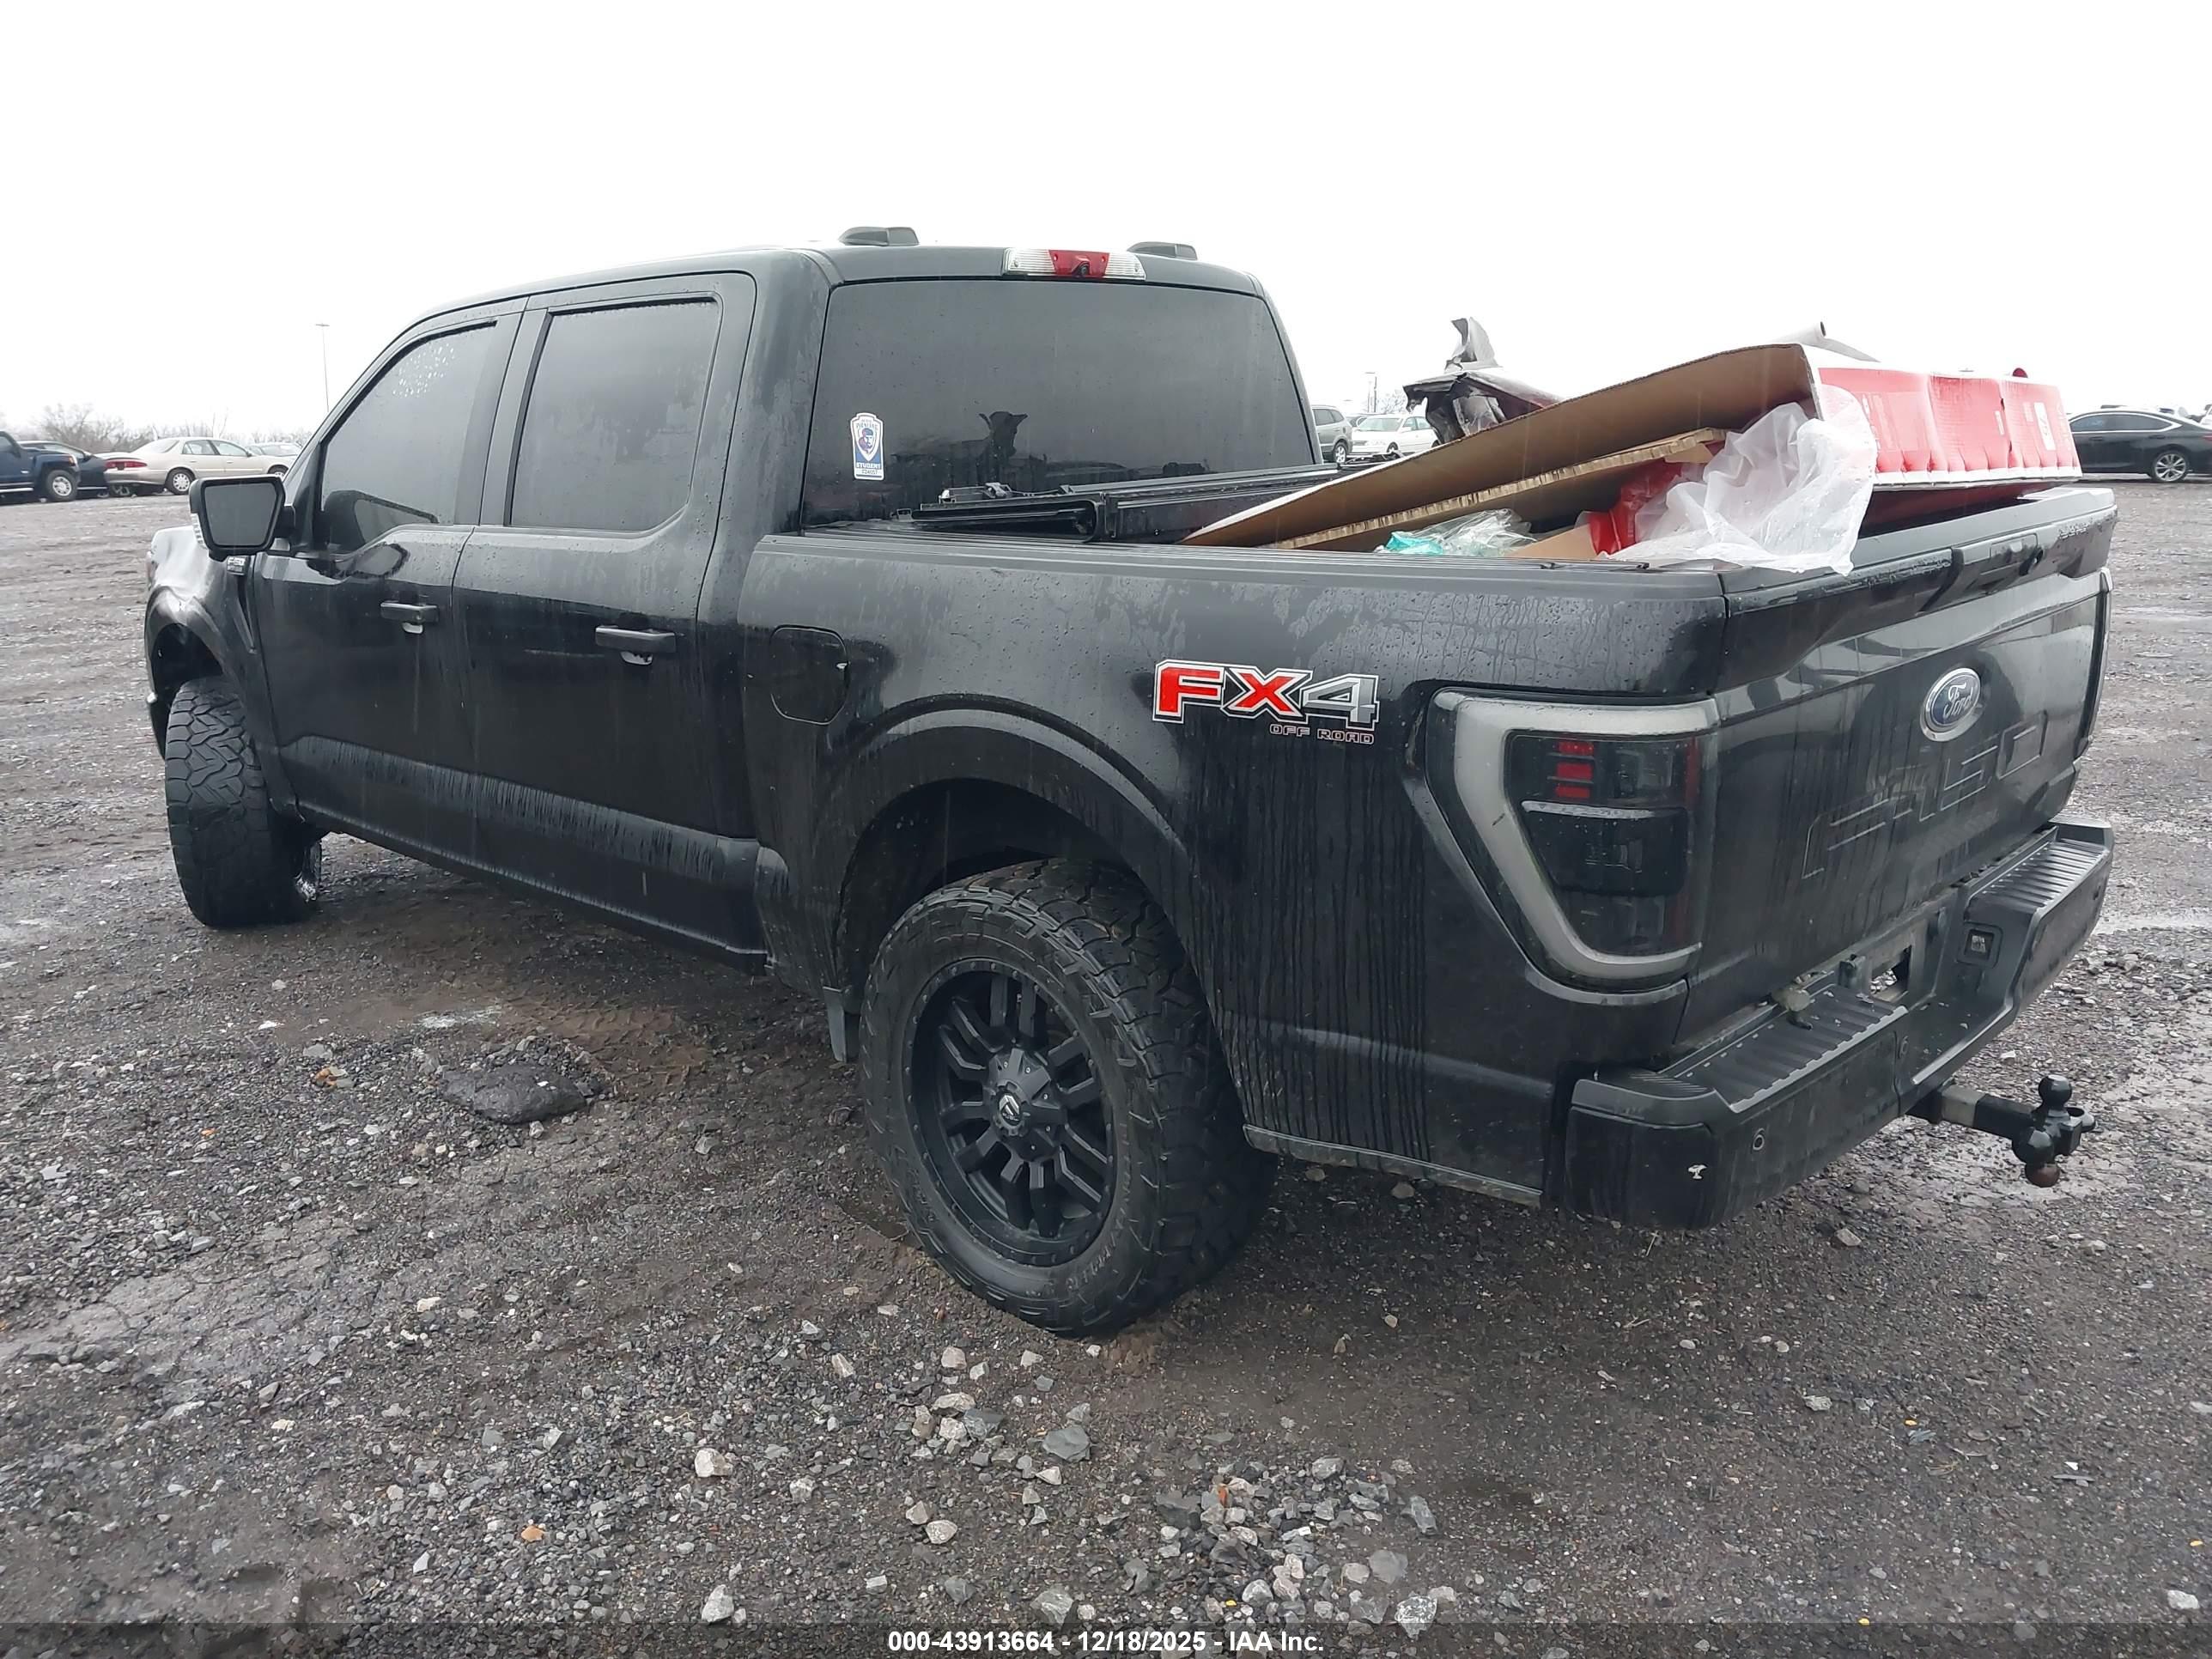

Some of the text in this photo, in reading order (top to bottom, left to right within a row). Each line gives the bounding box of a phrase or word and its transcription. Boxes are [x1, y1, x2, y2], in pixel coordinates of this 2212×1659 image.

[1152, 659, 1379, 731] FX4
[1943, 682, 1974, 719] Ford
[1269, 723, 1375, 744] OFF ROAD
